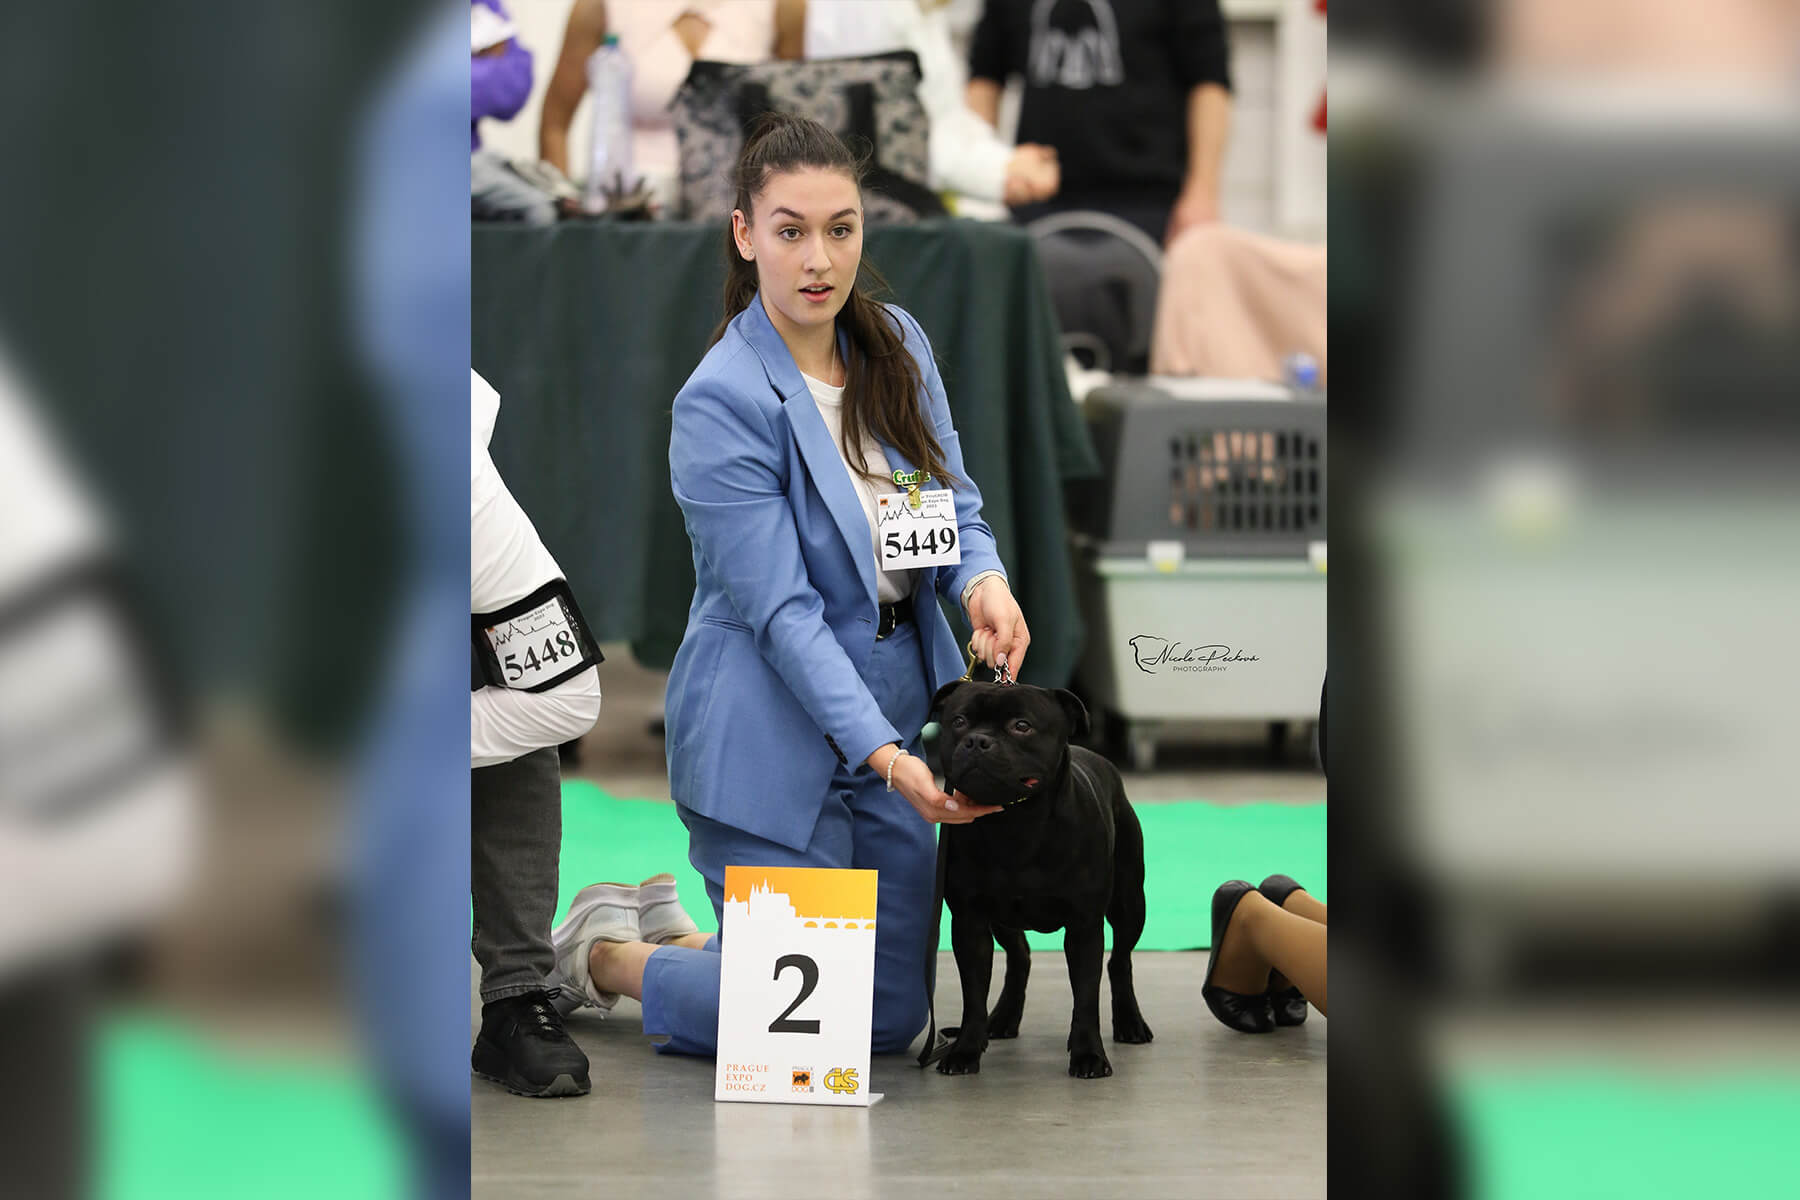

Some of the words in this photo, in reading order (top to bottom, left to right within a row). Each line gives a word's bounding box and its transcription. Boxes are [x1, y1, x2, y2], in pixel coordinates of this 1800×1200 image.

[885, 527, 956, 558] 5449
[505, 631, 576, 681] 5448
[768, 954, 821, 1034] 2
[726, 1063, 769, 1073] PRAGUE
[726, 1073, 753, 1082] EXPO
[725, 1083, 767, 1092] DOG.CZ
